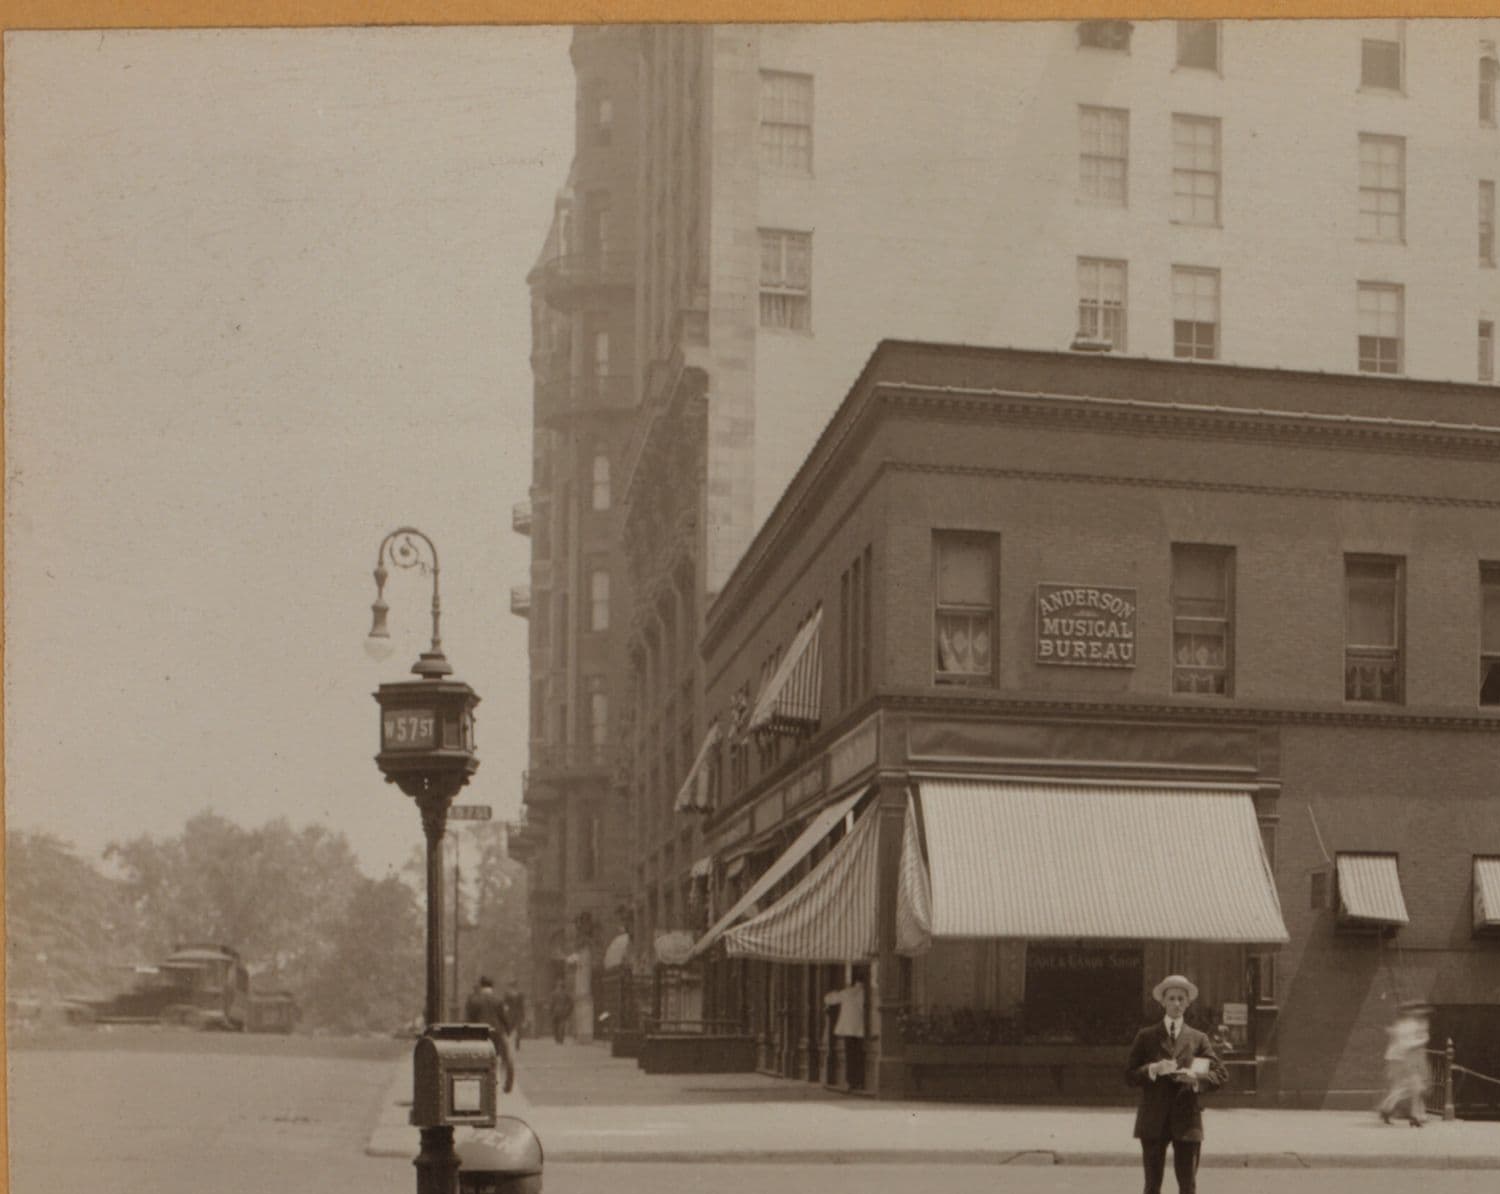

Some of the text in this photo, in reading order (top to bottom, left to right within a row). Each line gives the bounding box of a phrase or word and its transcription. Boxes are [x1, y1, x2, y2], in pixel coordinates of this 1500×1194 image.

[1039, 588, 1134, 618] ANDERSON
[1041, 618, 1132, 639] MUSICAL
[1039, 638, 1132, 659] BUREAU
[397, 717, 418, 741] 57
